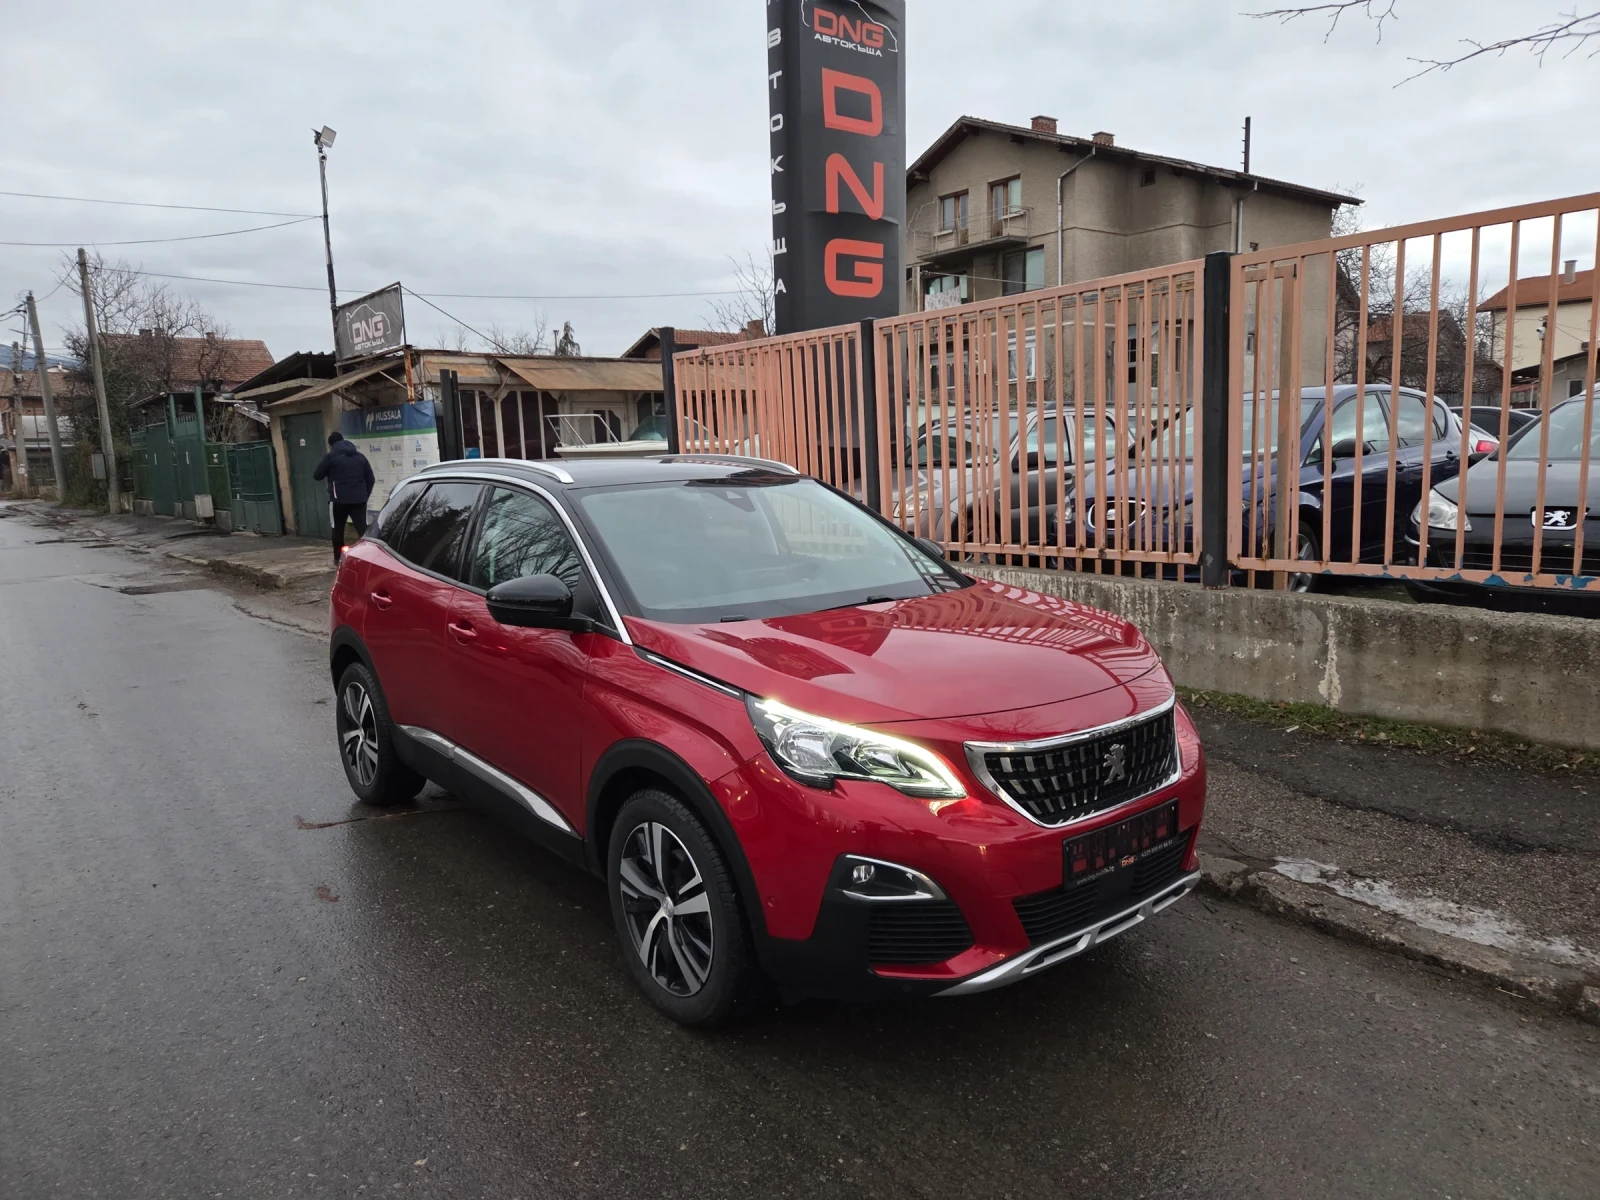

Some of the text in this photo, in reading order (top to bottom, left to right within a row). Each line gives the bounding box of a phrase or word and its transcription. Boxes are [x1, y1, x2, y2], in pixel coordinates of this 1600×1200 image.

[814, 7, 883, 48] DNG
[822, 67, 884, 298] DNG
[352, 314, 383, 344] DNG
[375, 409, 402, 422] MUSSALA
